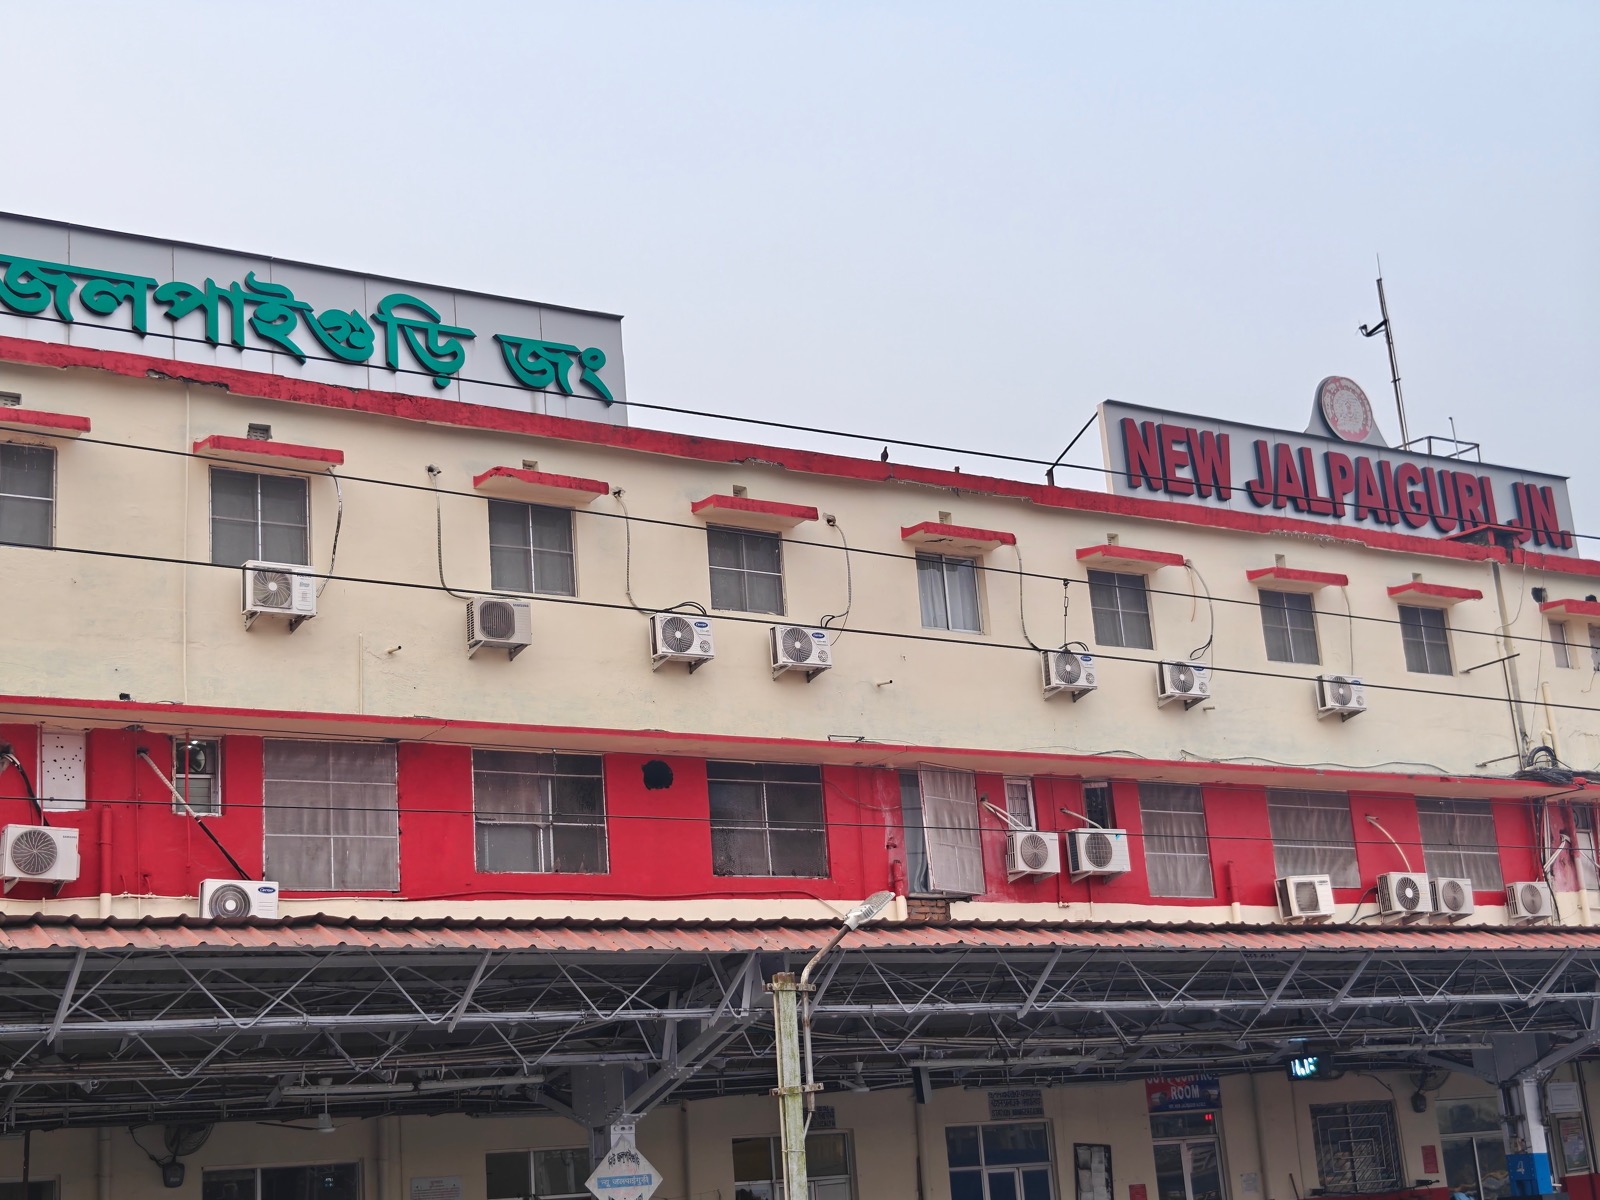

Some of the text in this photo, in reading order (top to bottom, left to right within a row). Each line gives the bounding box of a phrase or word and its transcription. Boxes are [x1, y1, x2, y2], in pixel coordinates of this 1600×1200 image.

[0, 254, 614, 405] জলপাইগুড়ি জং
[1120, 417, 1573, 550] NEW JALPAIGURI JN.
[1170, 1084, 1200, 1100] ROOM
[1517, 1160, 1525, 1175] 4
